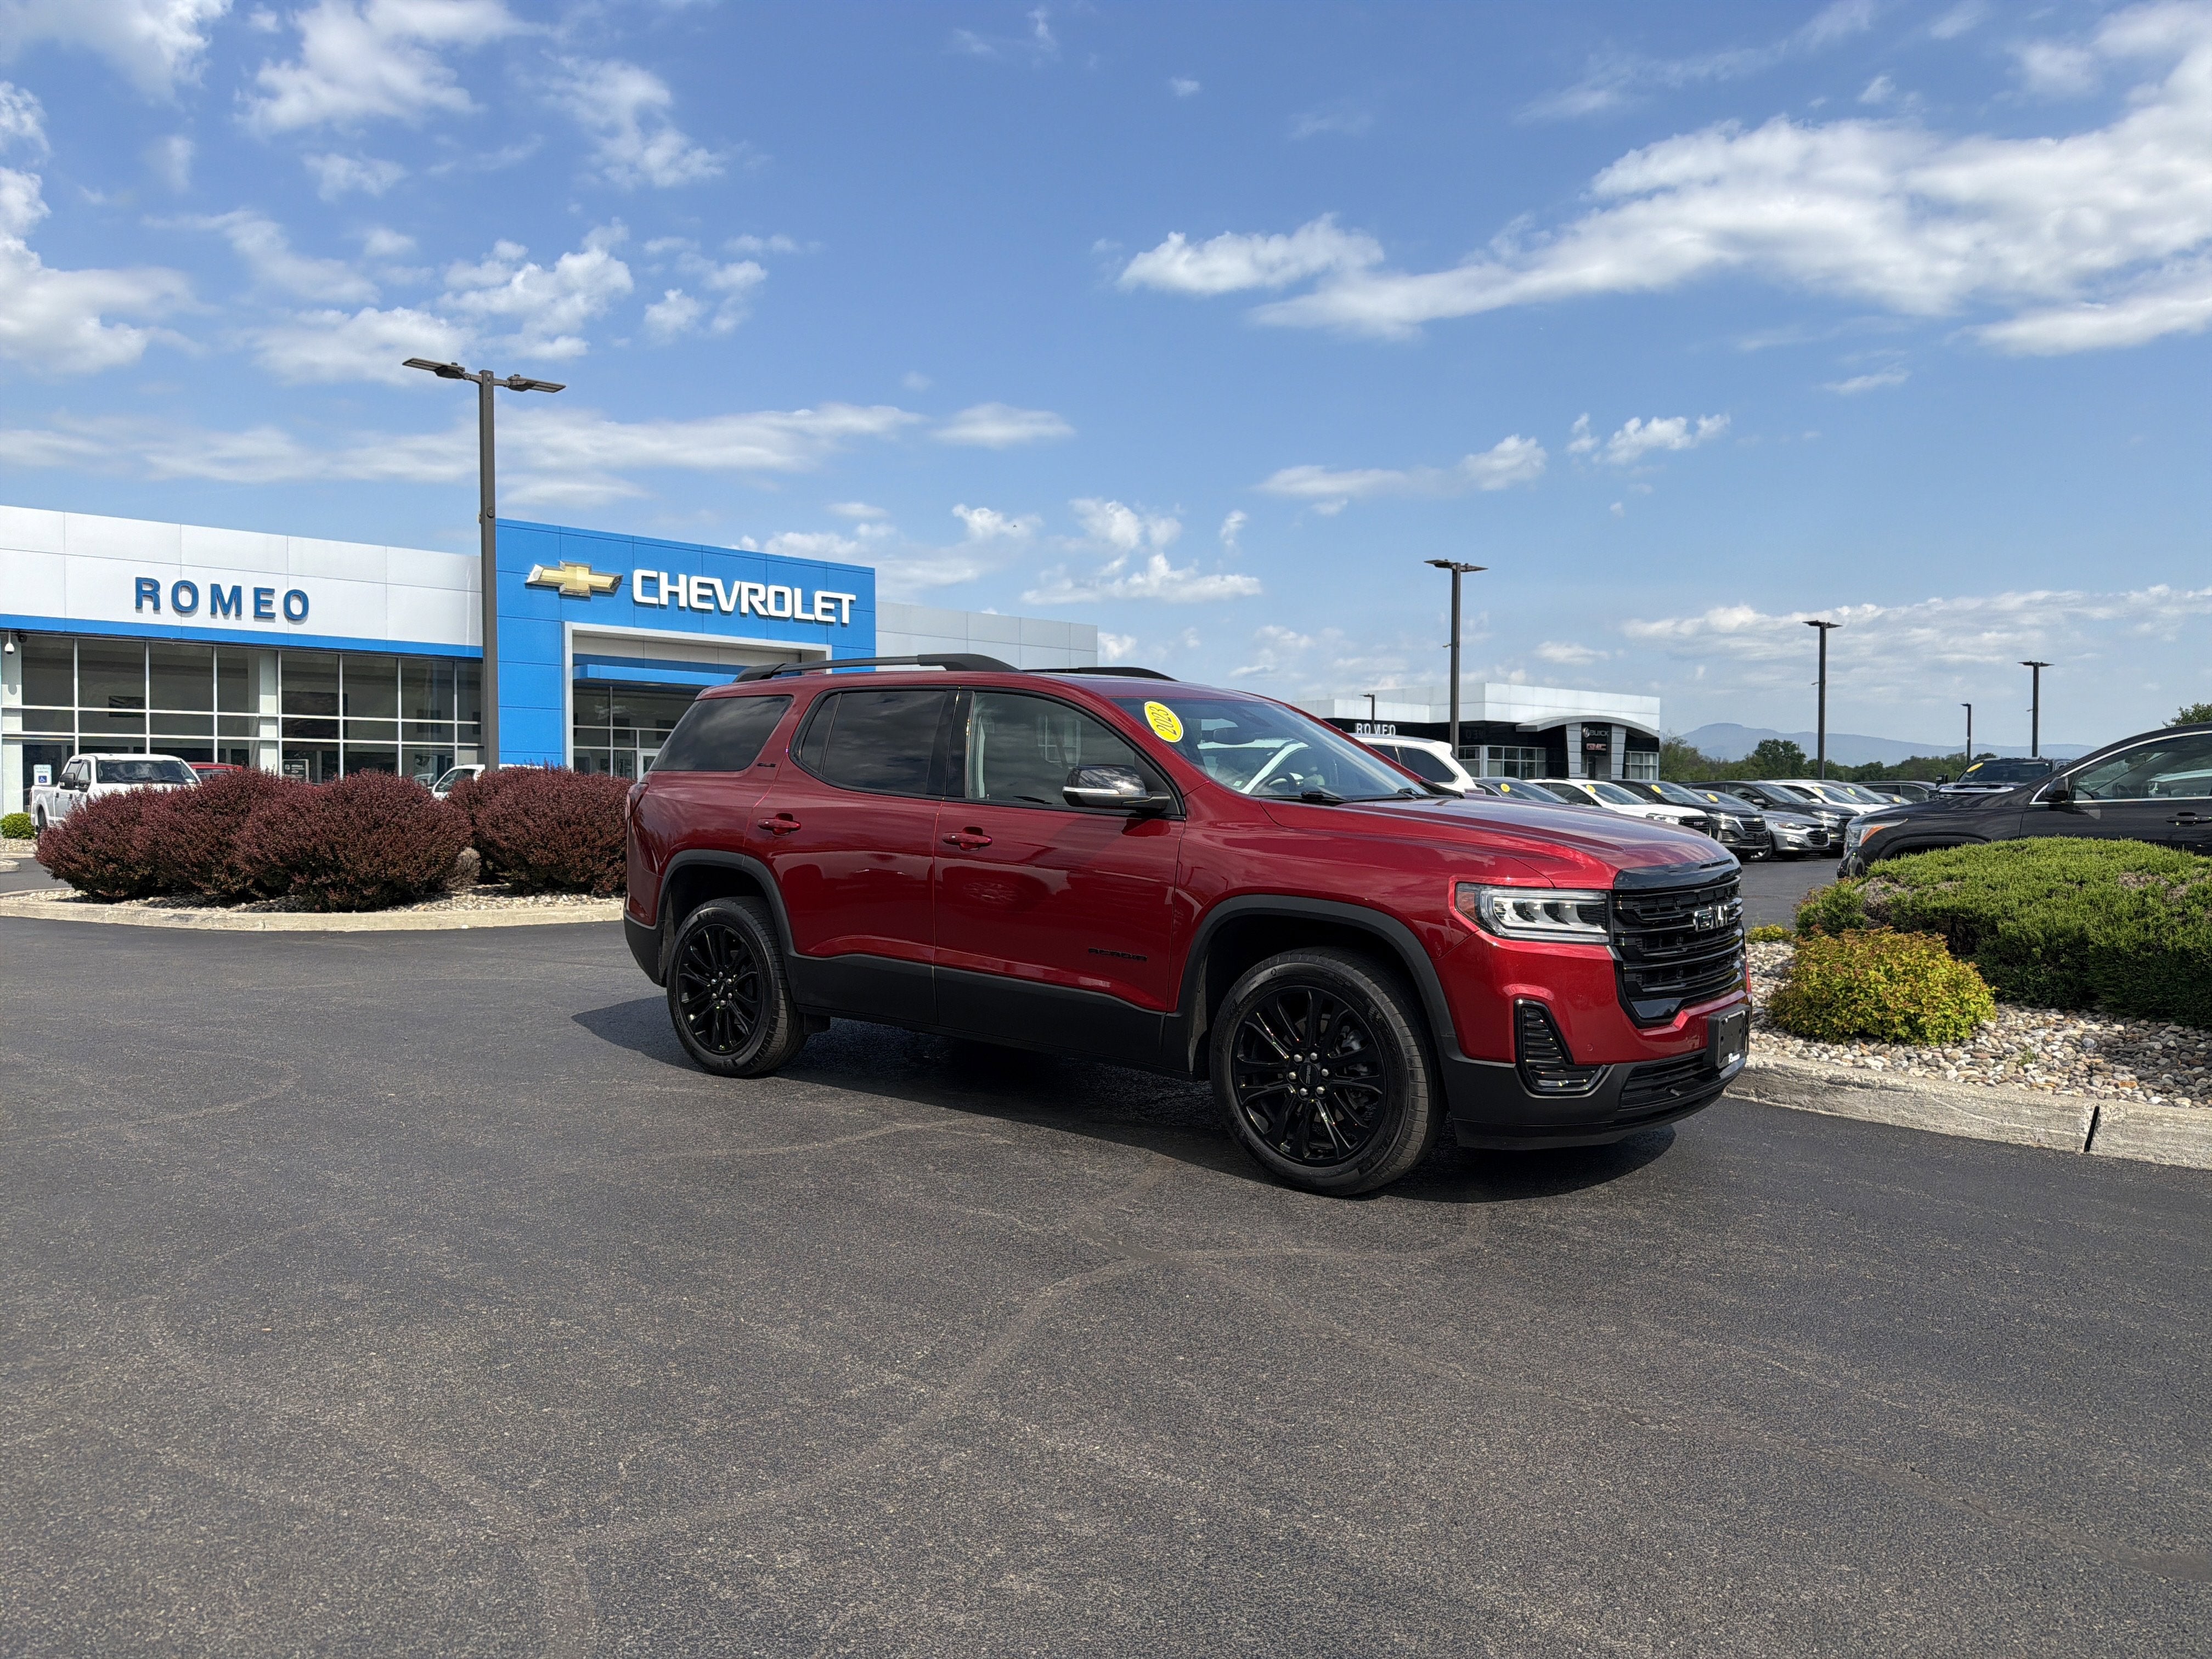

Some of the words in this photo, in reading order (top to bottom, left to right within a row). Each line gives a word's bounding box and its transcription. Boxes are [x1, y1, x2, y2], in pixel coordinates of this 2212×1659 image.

[134, 576, 310, 621] ROMEO
[633, 569, 856, 625] CHEVROLET
[1149, 706, 1177, 736] 2023
[1355, 723, 1396, 735] ROMEO
[1693, 901, 1738, 932] GMC
